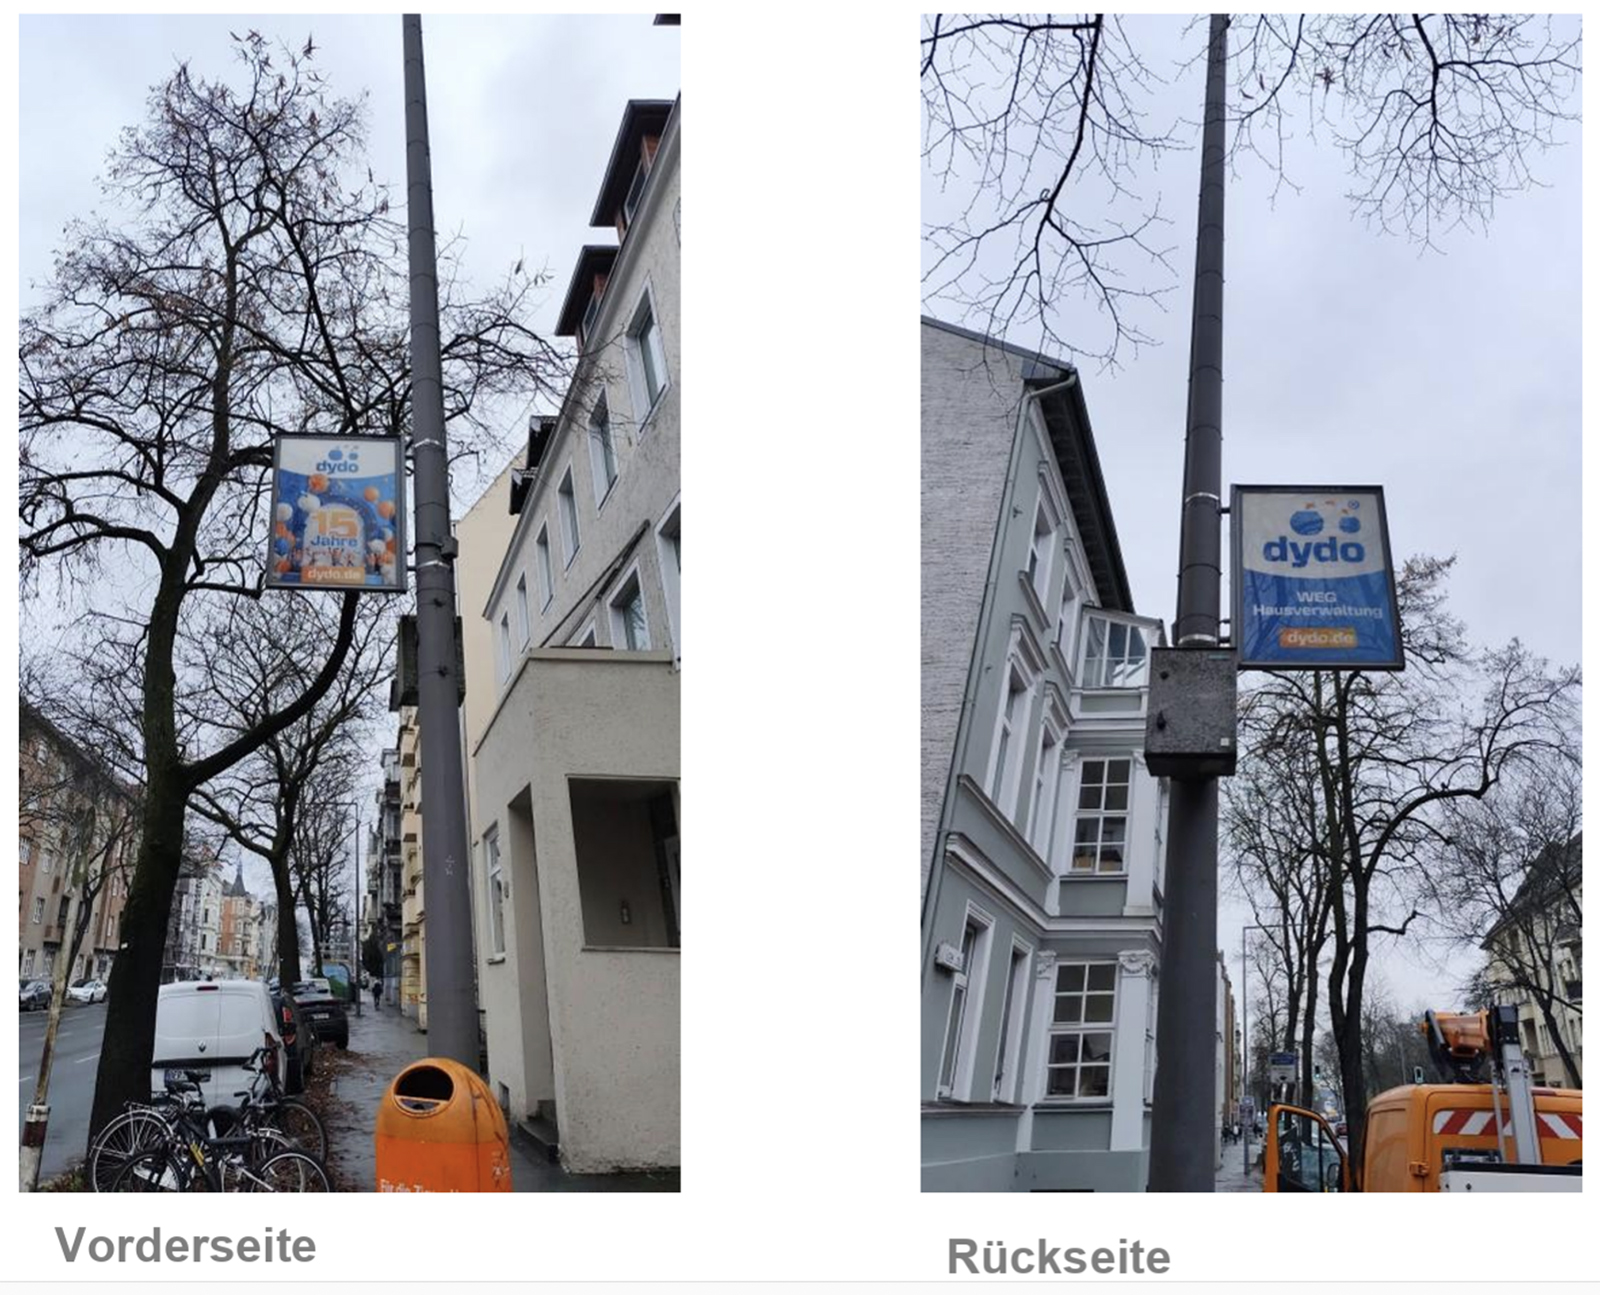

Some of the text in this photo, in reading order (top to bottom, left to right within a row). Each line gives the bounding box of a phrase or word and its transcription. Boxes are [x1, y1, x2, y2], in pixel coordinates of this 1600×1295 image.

[316, 460, 359, 474] dydo
[312, 509, 358, 537] 15
[310, 535, 358, 548] Jahre
[1263, 535, 1365, 568] dydo
[307, 568, 361, 582] dydo.de
[1296, 591, 1337, 603] WEG
[1252, 604, 1383, 619] Hausverwaltung
[1287, 630, 1354, 646] dydo.de
